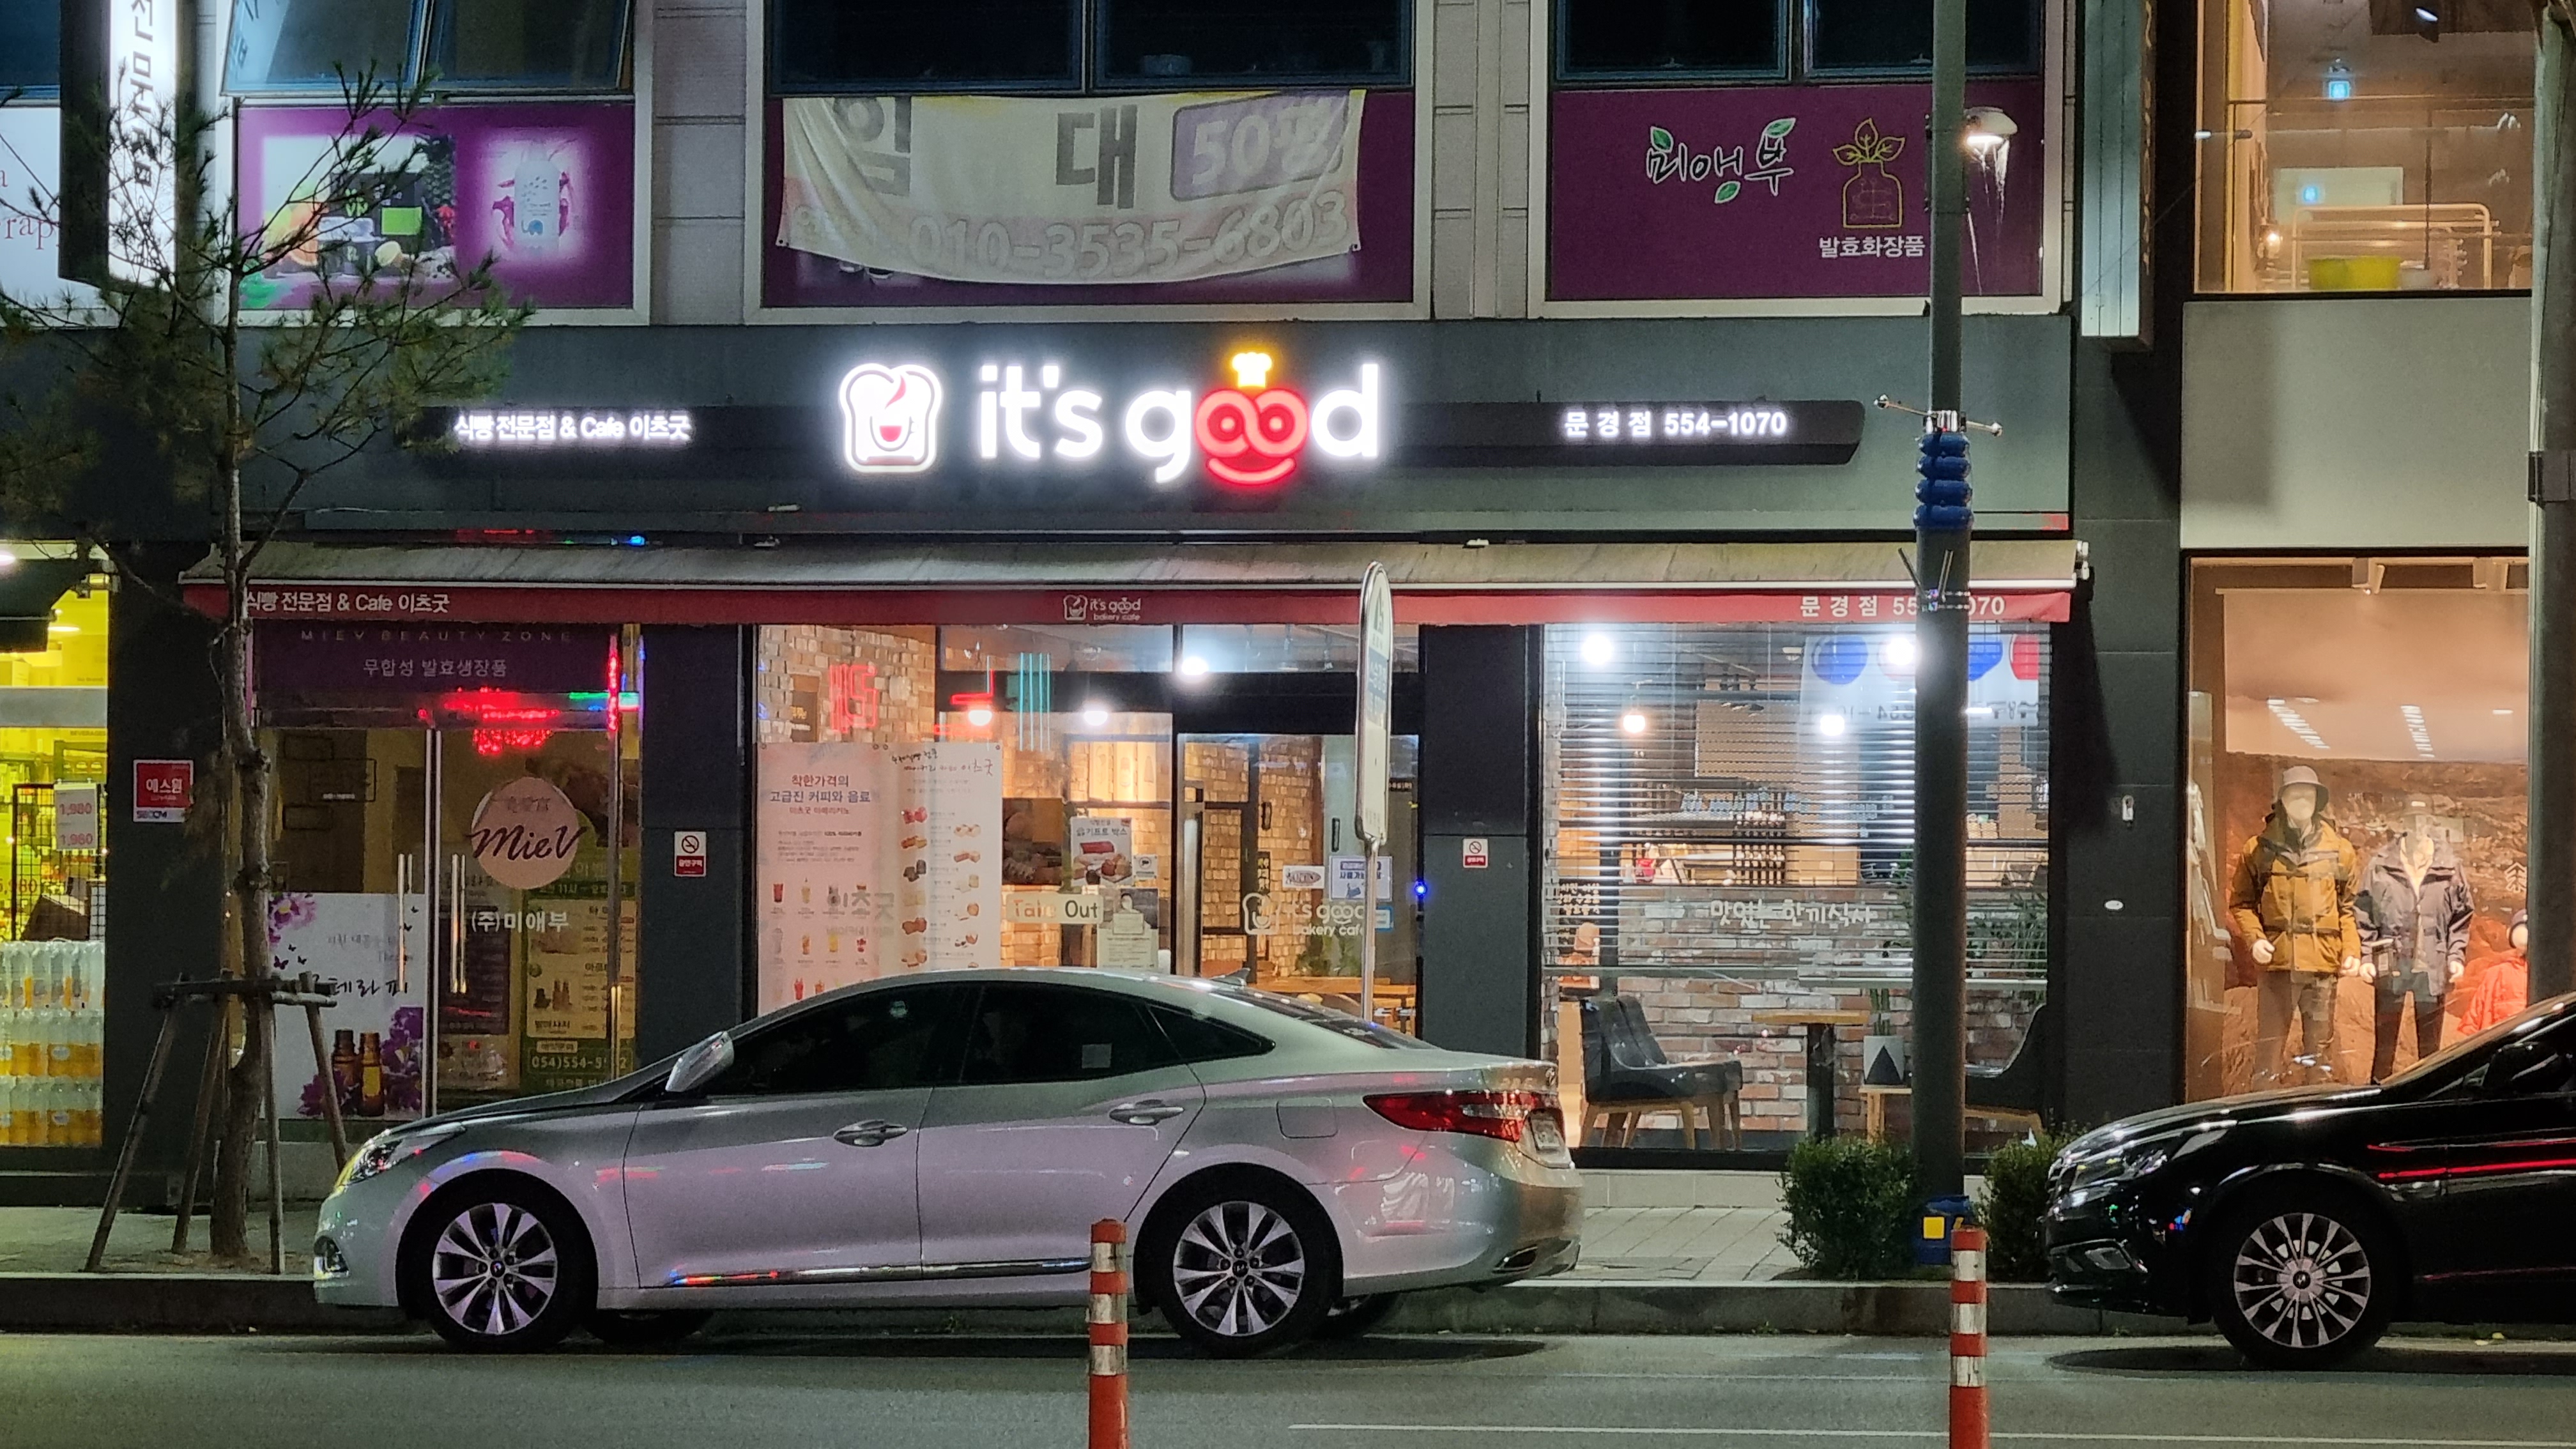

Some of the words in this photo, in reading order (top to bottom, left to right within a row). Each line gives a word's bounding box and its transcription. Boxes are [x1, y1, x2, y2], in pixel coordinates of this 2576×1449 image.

[1054, 105, 1140, 210] 대
[1818, 234, 1926, 259] 발효화장품
[453, 411, 493, 441] 식빵
[496, 411, 556, 441] 전문점
[559, 415, 577, 440] &
[579, 414, 625, 440] Cafe
[629, 411, 692, 441] 이츠굿
[978, 362, 1104, 460] it's
[1123, 362, 1380, 484] good
[1664, 411, 1788, 436] 554-1070
[281, 592, 332, 613] 전문점
[337, 594, 351, 611] &
[355, 594, 392, 612] Cafe
[397, 592, 451, 615] 이츠굿
[1090, 598, 1107, 611] it's
[1109, 597, 1141, 614] good
[381, 631, 486, 641] BEAUTY
[501, 631, 572, 642] ZONE
[363, 659, 414, 677] 무합성
[421, 659, 507, 677] 발효생장품
[145, 778, 183, 794] 에스원
[791, 774, 849, 788] 착한가격의
[769, 790, 804, 803] 고급진
[808, 790, 843, 803] 커피와
[847, 790, 871, 803] 음료
[467, 824, 588, 861] MieV
[1064, 900, 1099, 919] Out
[471, 910, 571, 933] (주)미애부
